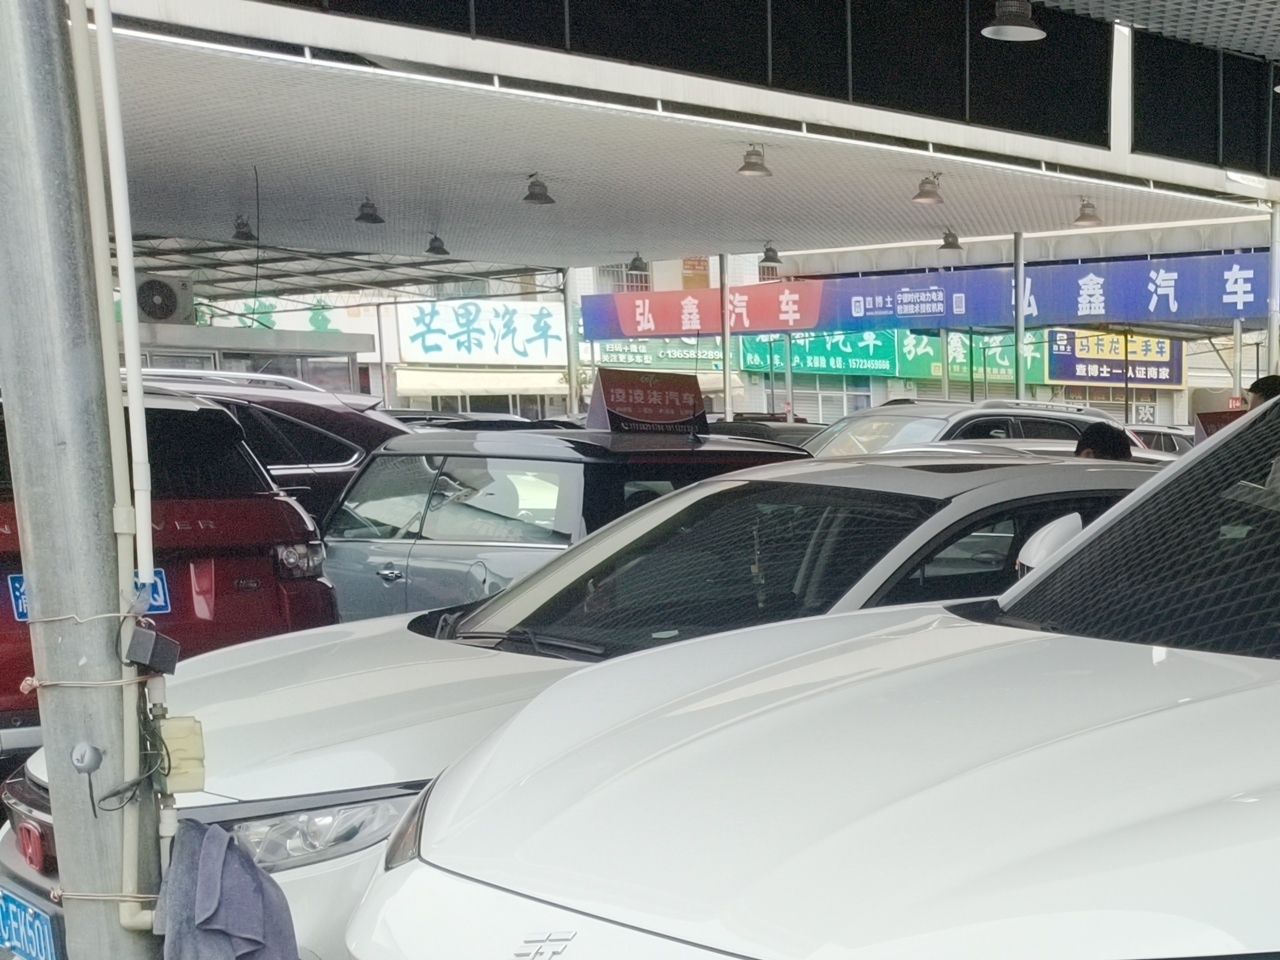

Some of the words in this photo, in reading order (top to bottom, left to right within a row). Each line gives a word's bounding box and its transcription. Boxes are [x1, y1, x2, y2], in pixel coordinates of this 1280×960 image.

[409, 301, 562, 358] 芒果汽车
[634, 288, 801, 332] 弘鑫汽车
[1080, 337, 1166, 357] 马卡龙二手车
